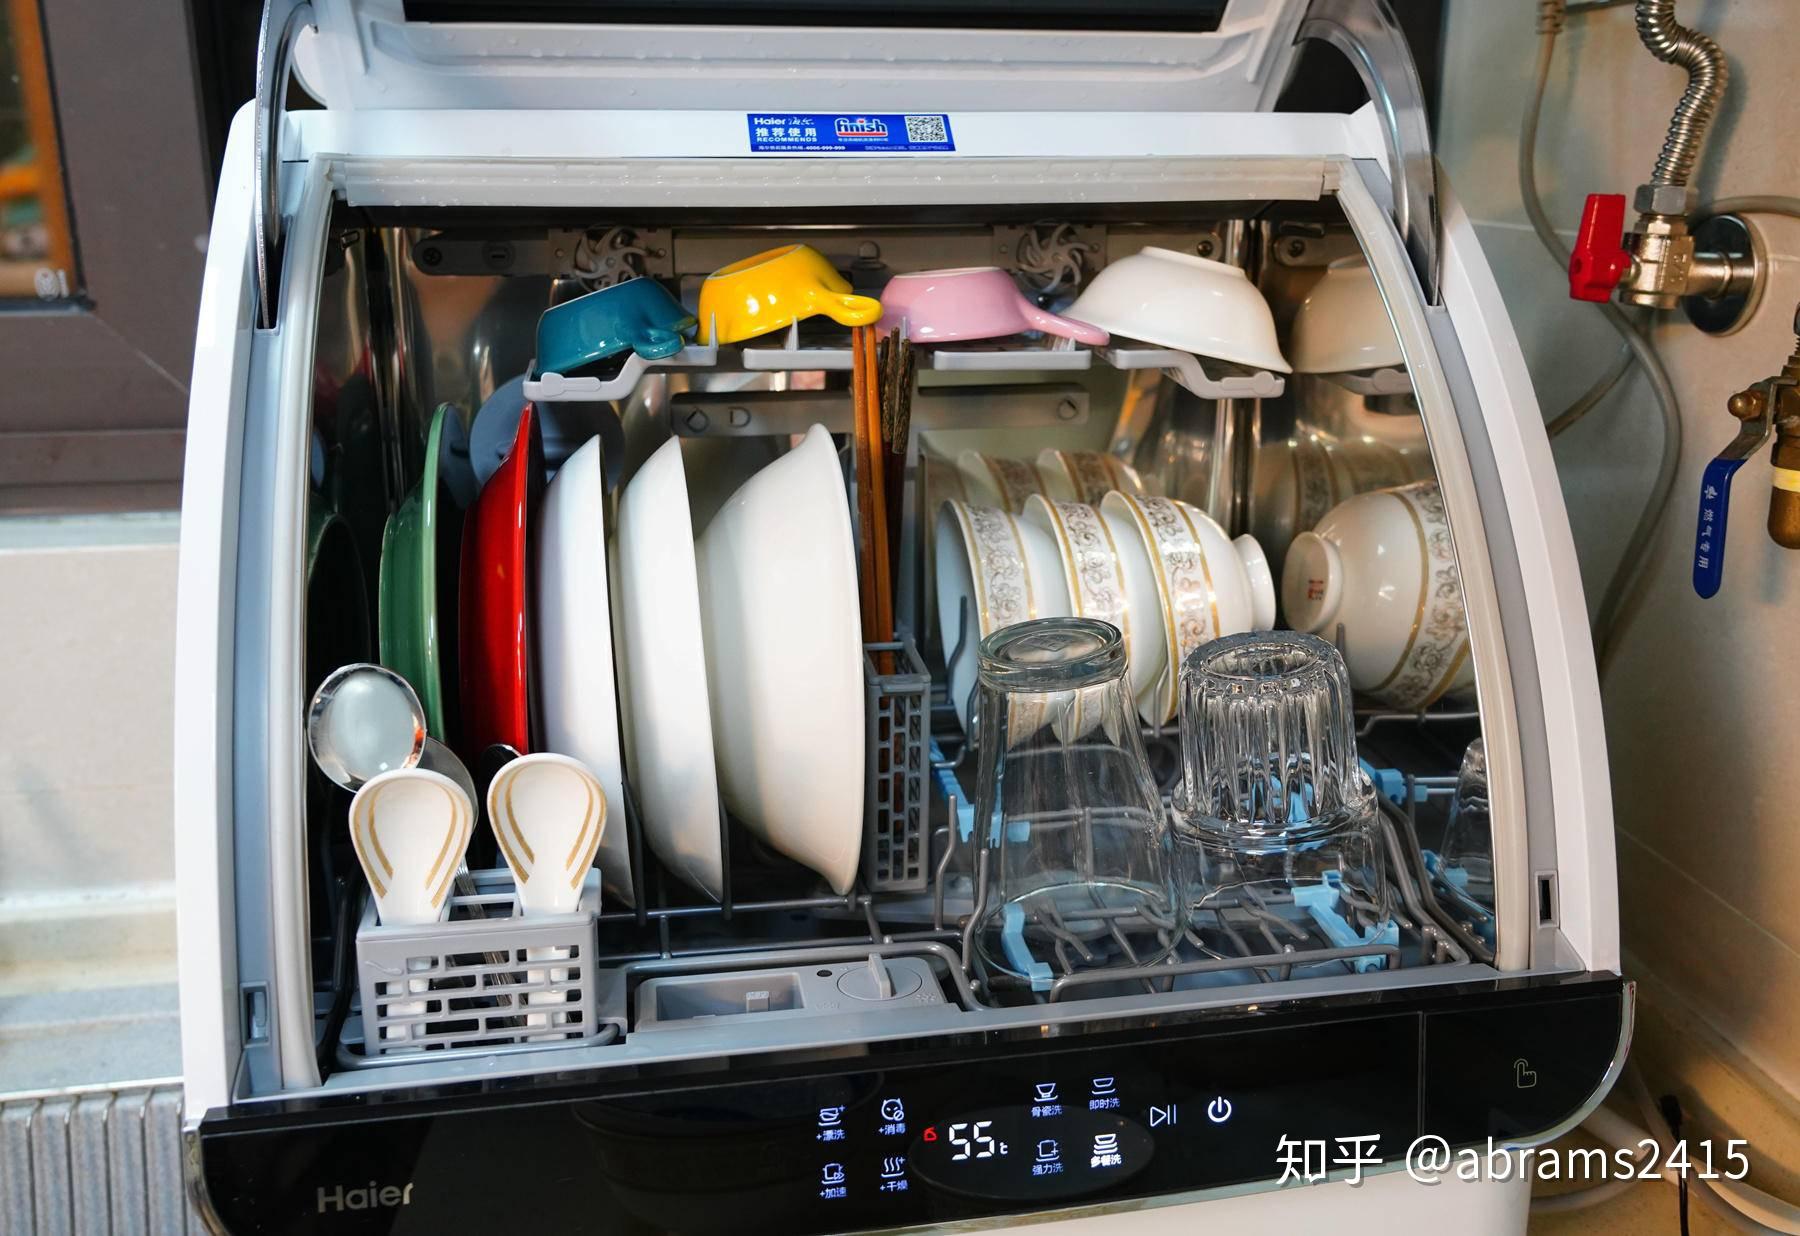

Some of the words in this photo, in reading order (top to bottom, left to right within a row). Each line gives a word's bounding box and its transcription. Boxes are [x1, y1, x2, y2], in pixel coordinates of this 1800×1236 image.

[754, 117, 785, 125] Haier
[837, 119, 886, 132] finish
[755, 127, 817, 137] 推荐使用
[1089, 1097, 1120, 1110] 即时洗
[1032, 1162, 1064, 1176] 强力洗
[317, 1180, 414, 1213] Haier
